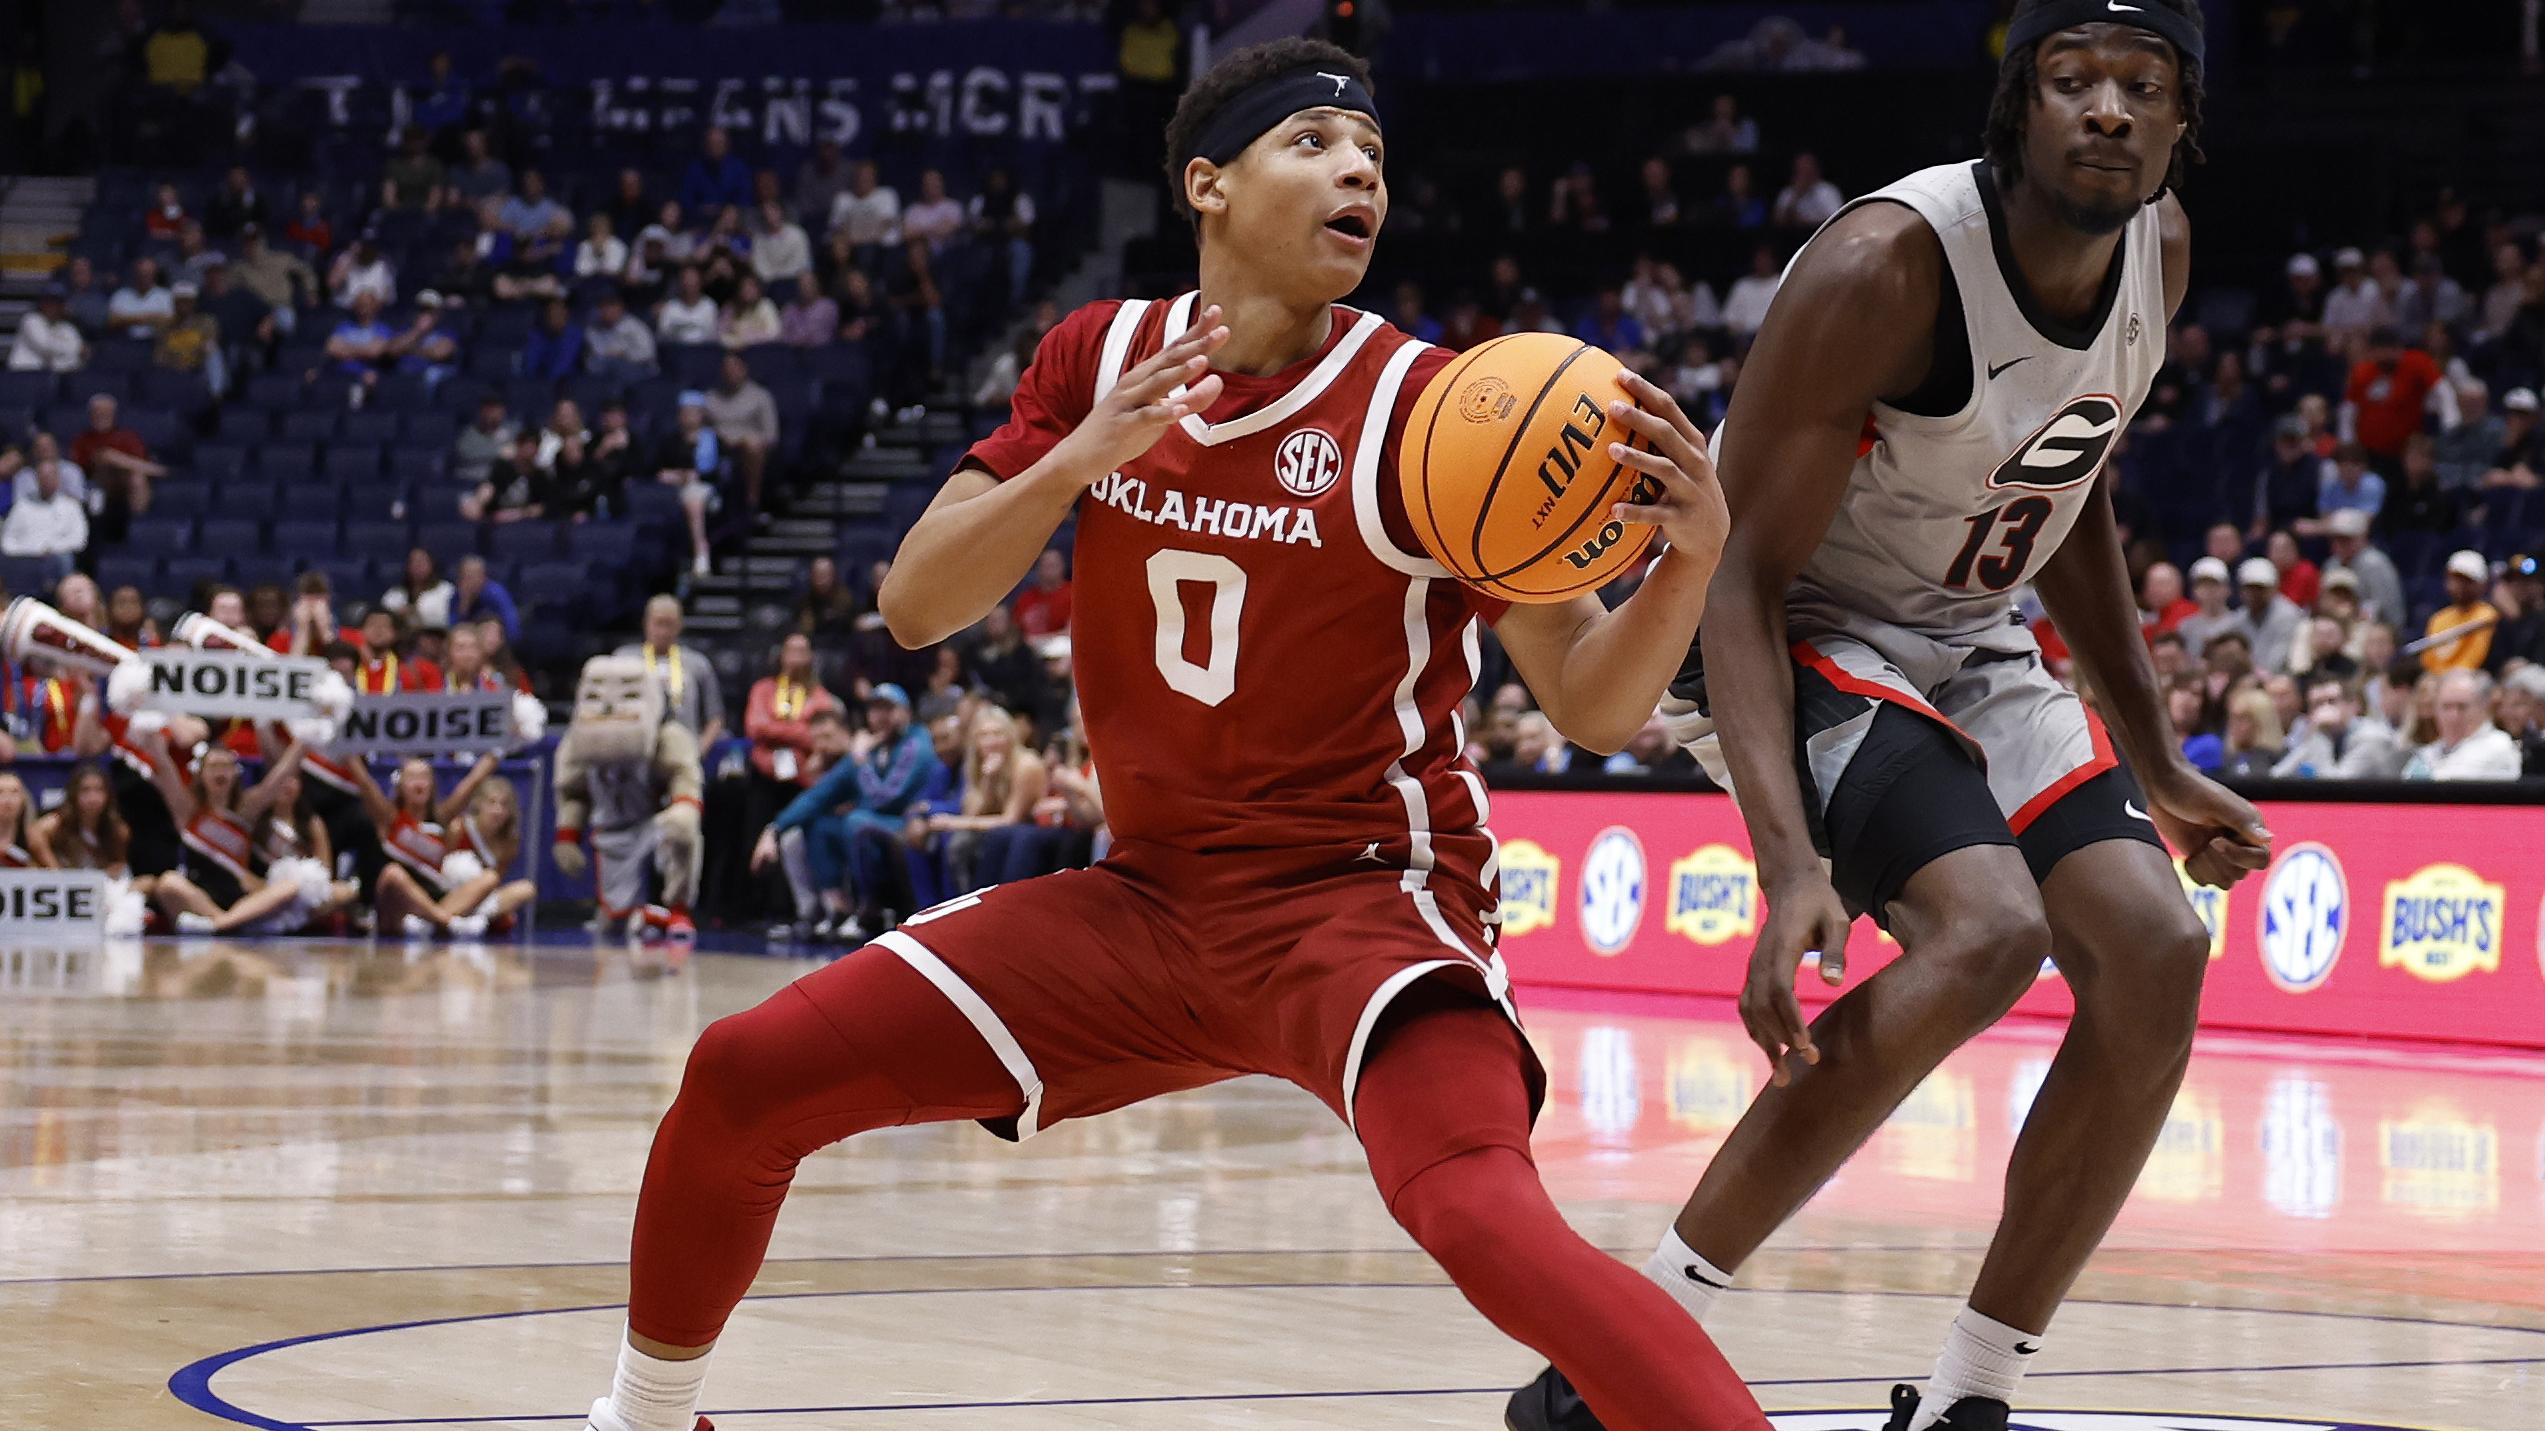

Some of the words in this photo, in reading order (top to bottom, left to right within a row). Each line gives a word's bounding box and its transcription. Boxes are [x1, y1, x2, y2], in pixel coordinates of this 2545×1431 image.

[1279, 431, 1337, 493] SEC
[1537, 391, 1607, 499] EVO
[1090, 470, 1322, 549] OKLAHOMA
[1531, 495, 1557, 531] NXT
[1943, 495, 2054, 591] 13
[1145, 548, 1248, 708] 0
[151, 663, 314, 701] NOISE
[345, 704, 503, 741] NOISE
[0, 886, 93, 920] ISE
[2392, 896, 2493, 953] BUSH'S
